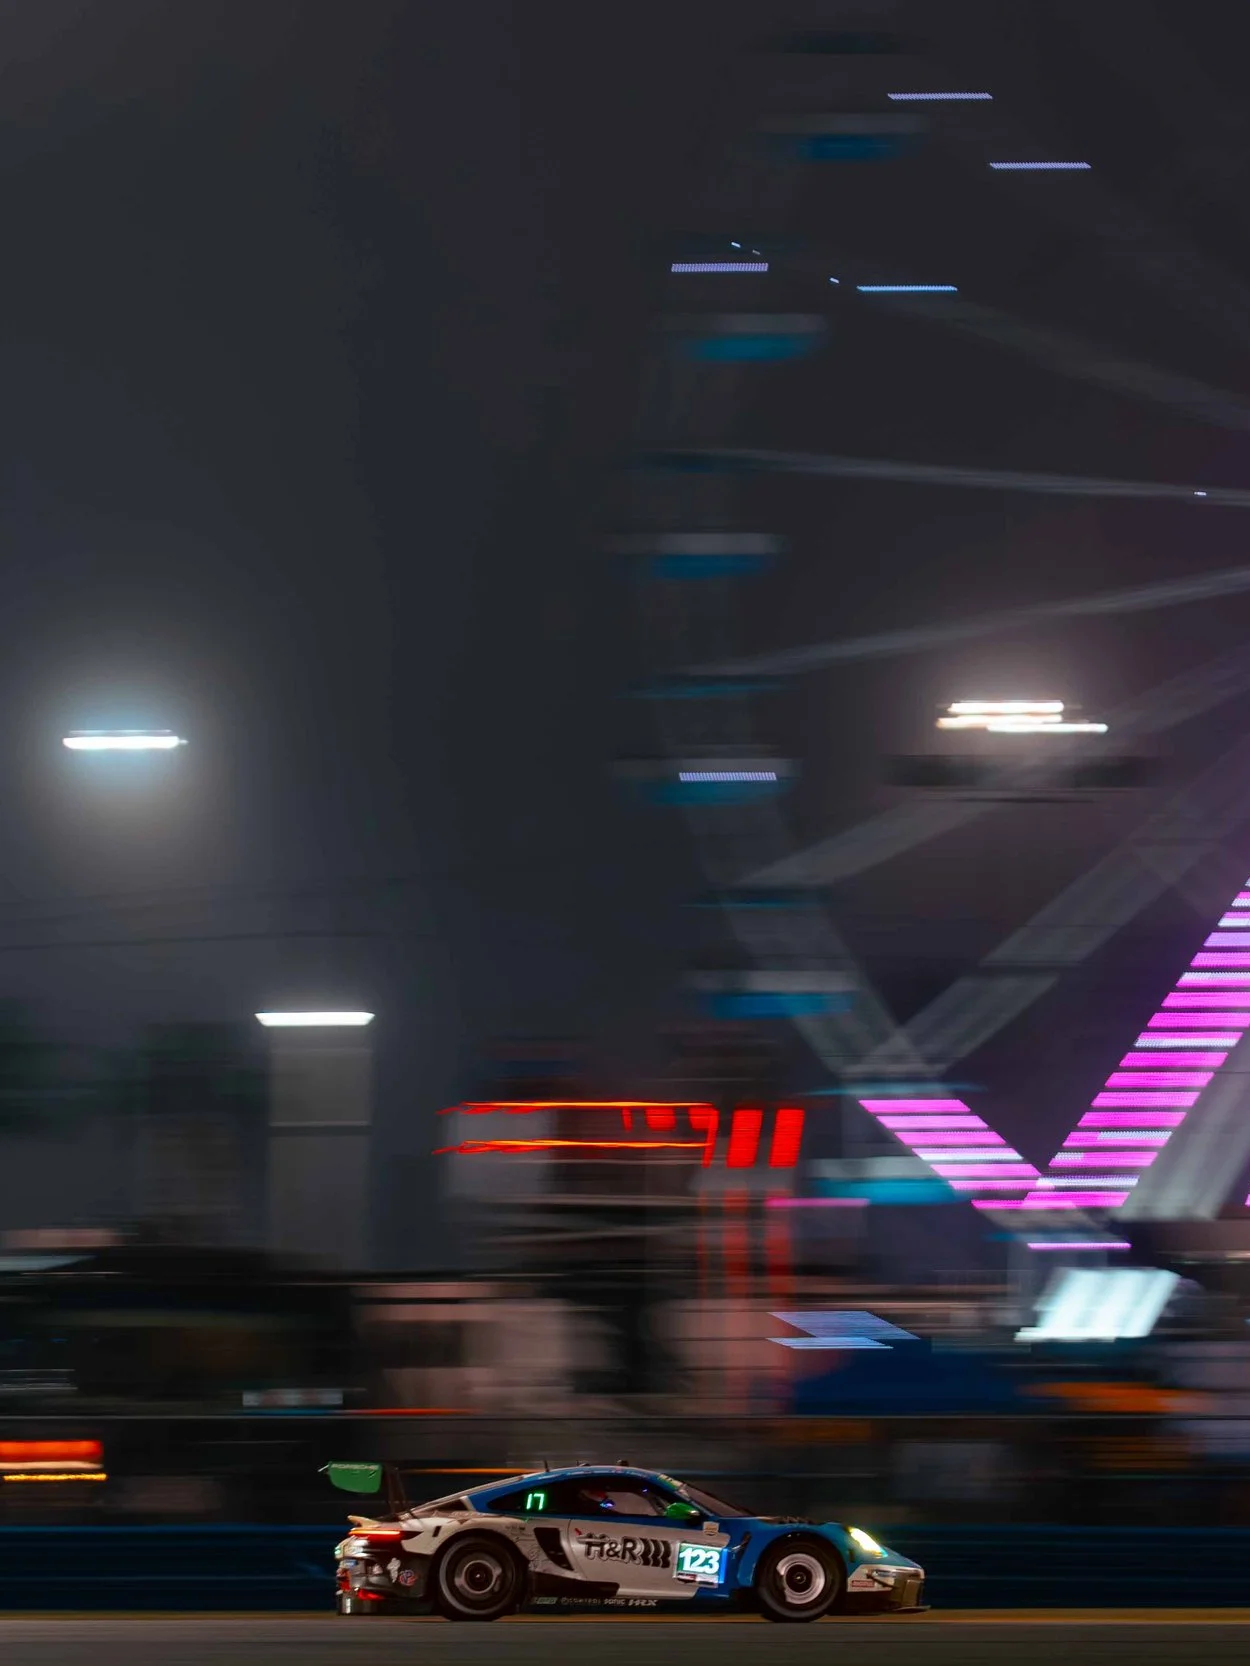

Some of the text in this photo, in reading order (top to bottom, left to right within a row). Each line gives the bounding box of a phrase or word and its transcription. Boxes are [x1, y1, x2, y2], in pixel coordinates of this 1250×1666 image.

[525, 1492, 545, 1511] 17
[580, 1533, 638, 1563] H&R
[679, 1547, 721, 1575] 123
